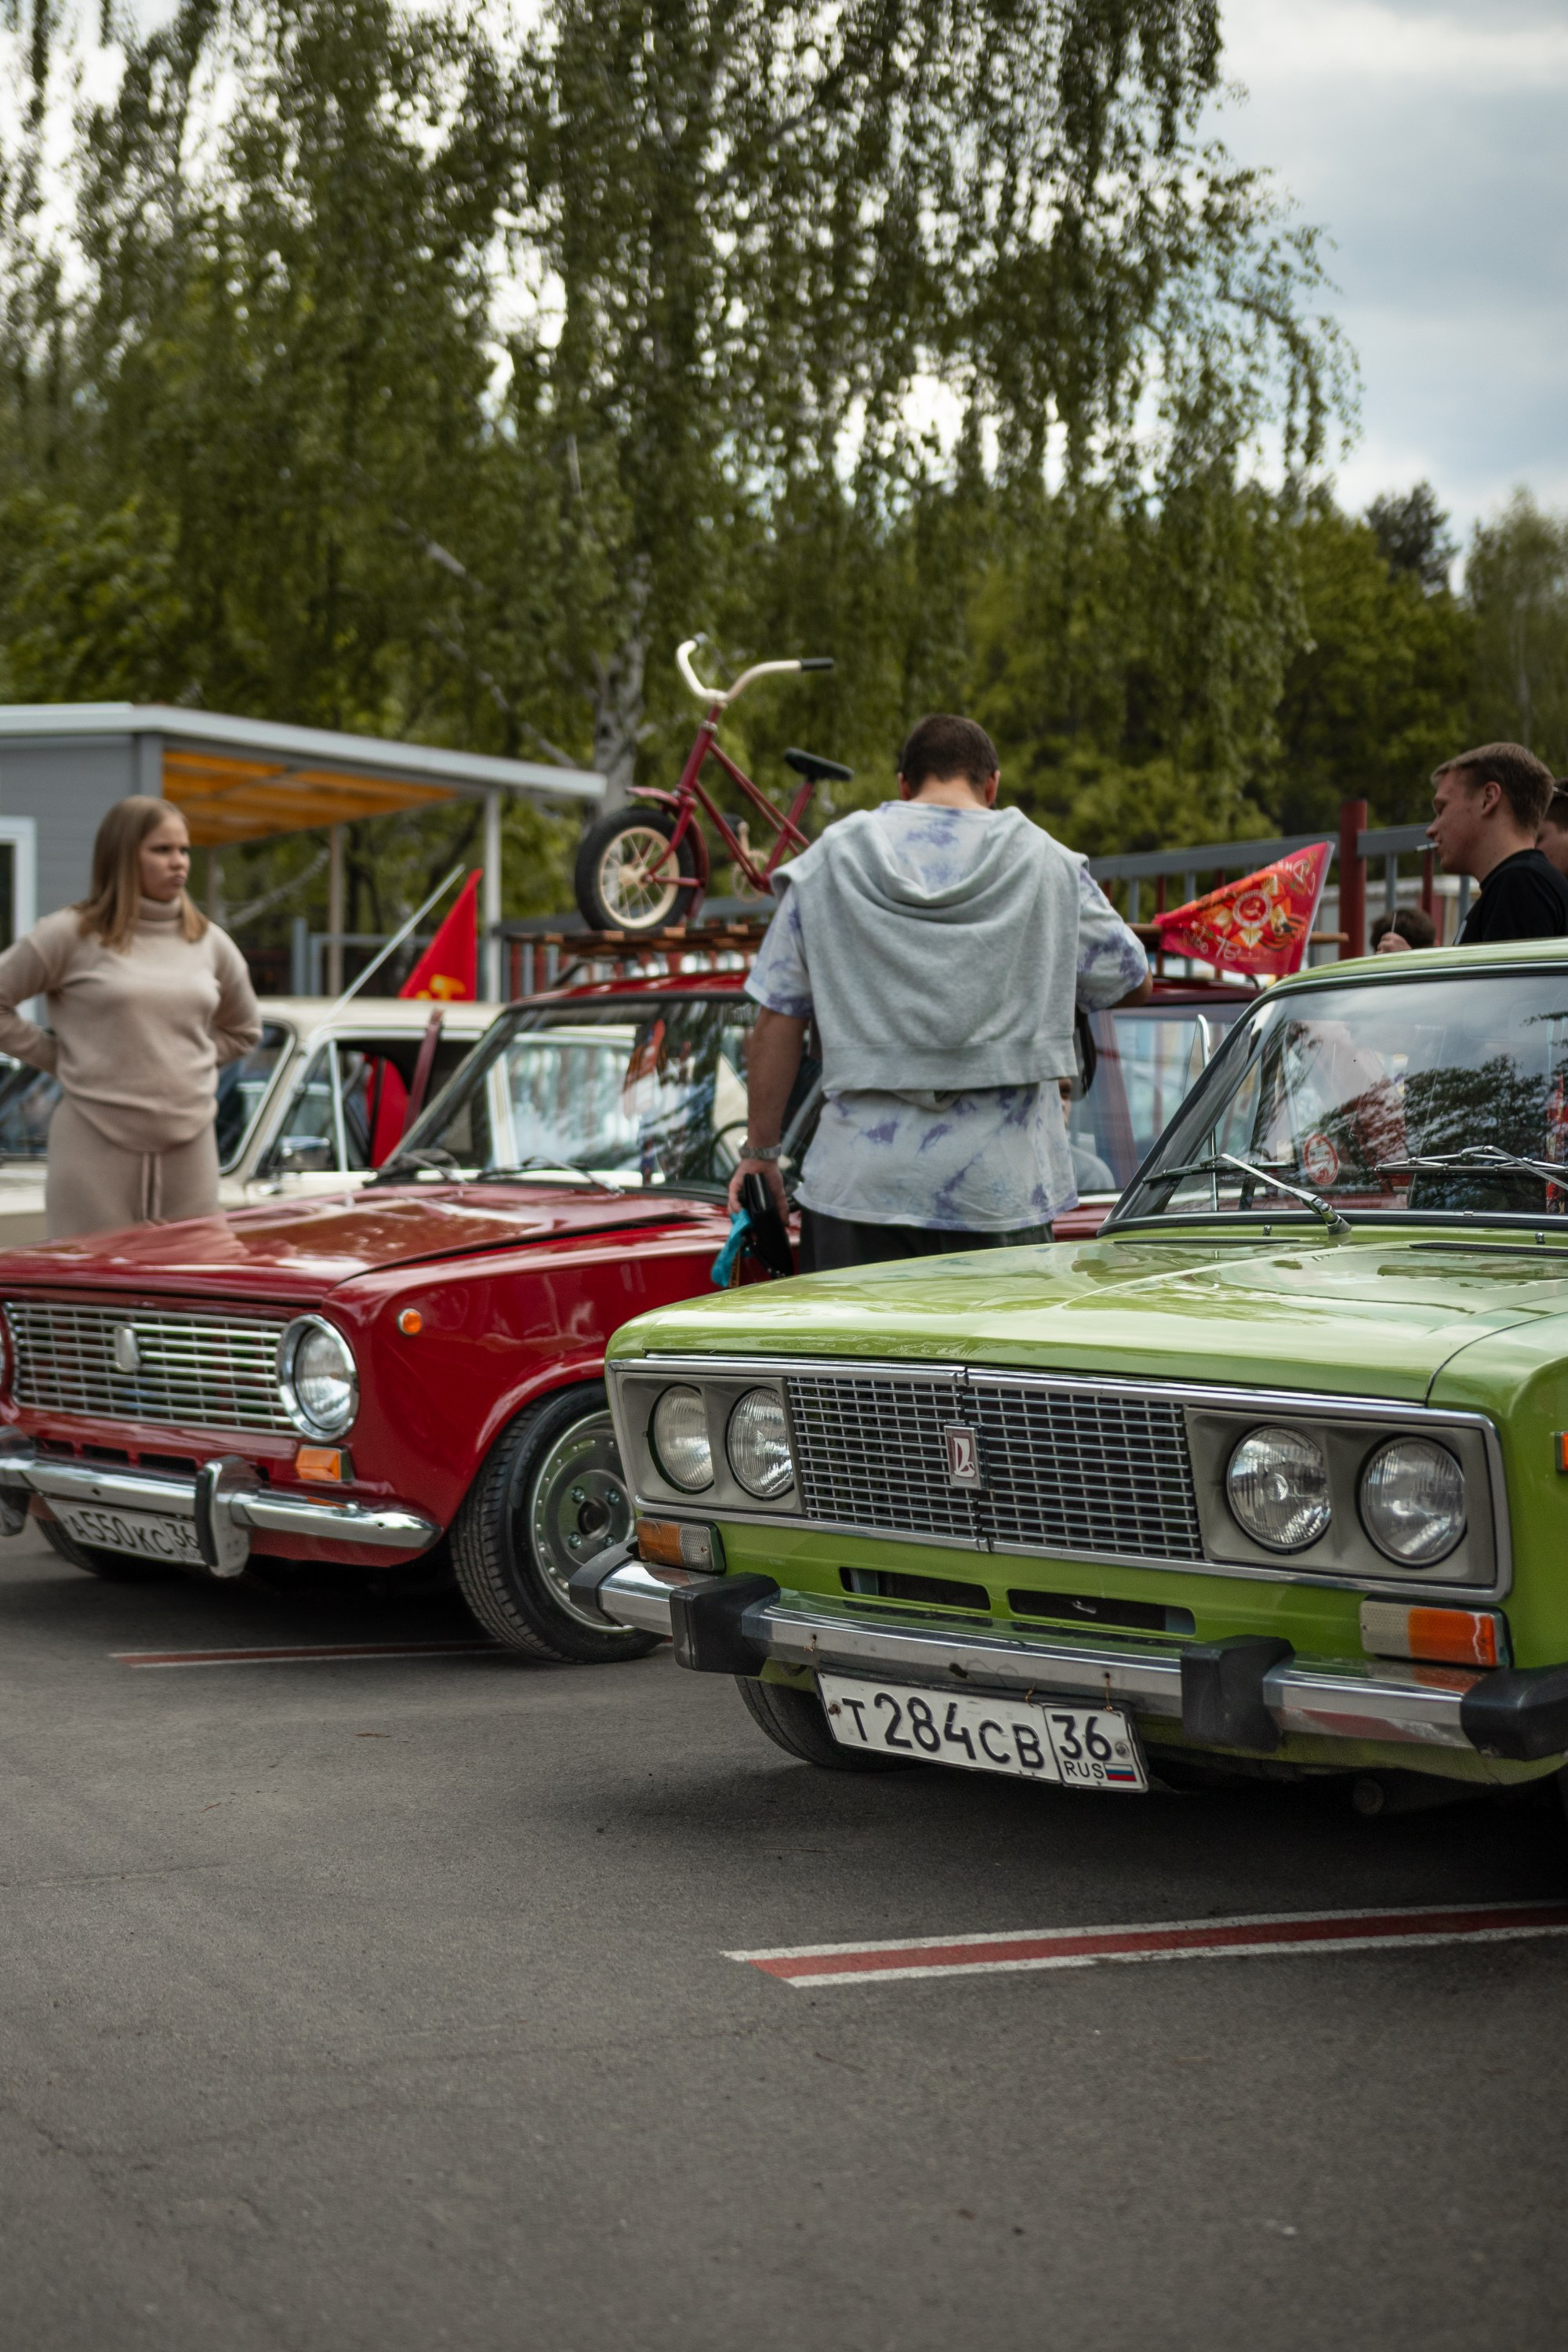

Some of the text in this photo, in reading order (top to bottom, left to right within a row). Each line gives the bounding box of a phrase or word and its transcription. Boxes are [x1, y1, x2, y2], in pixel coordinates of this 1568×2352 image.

[165, 1523, 199, 1549] 36
[841, 1692, 1112, 1769] Т284СВ 36
[1065, 1760, 1105, 1779] RUS
